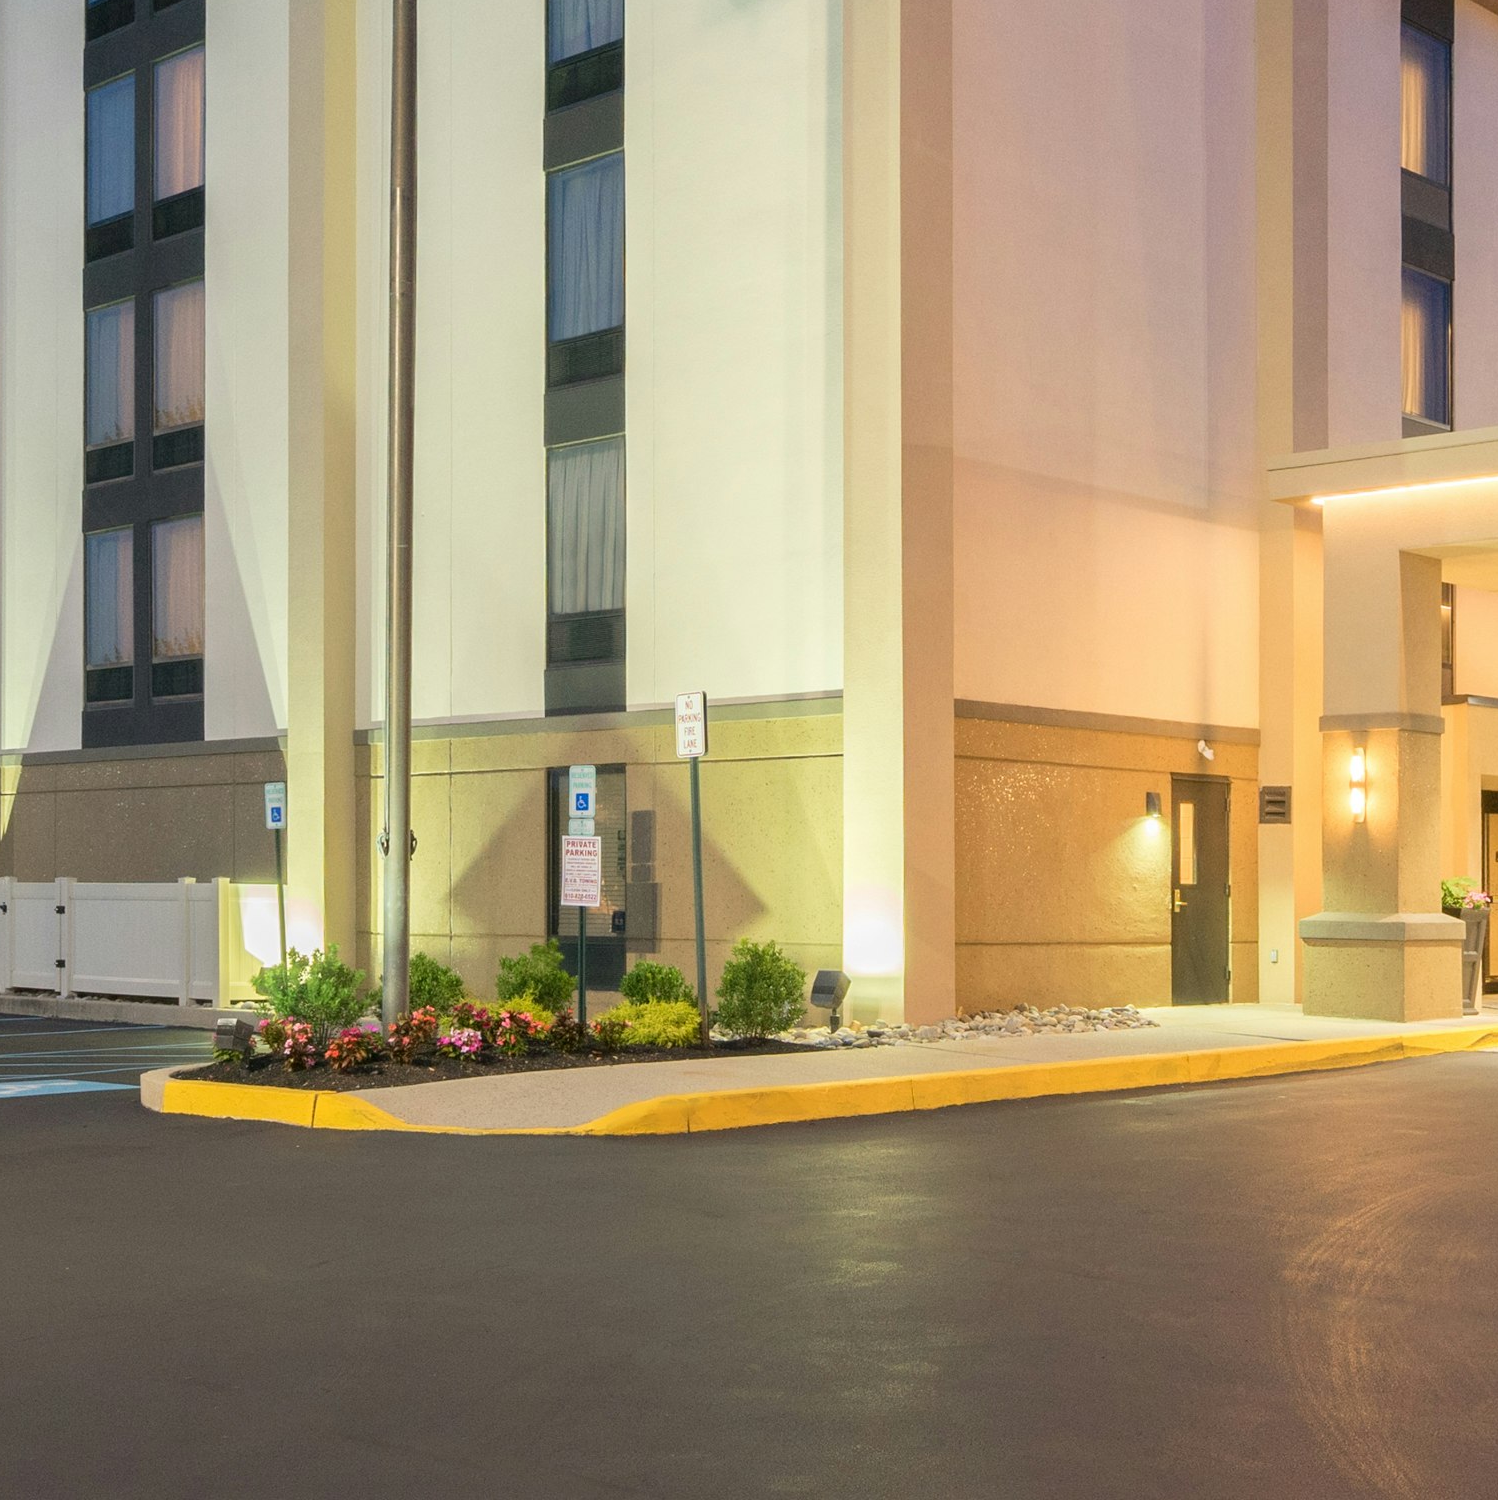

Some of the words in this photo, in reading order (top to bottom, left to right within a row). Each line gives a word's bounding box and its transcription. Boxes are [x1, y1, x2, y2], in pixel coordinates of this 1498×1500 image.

[684, 699, 694, 710] NO
[677, 712, 701, 723] PARKING
[684, 726, 696, 736] FIRE
[683, 739, 697, 749] LANE
[565, 849, 598, 857] PARKING
